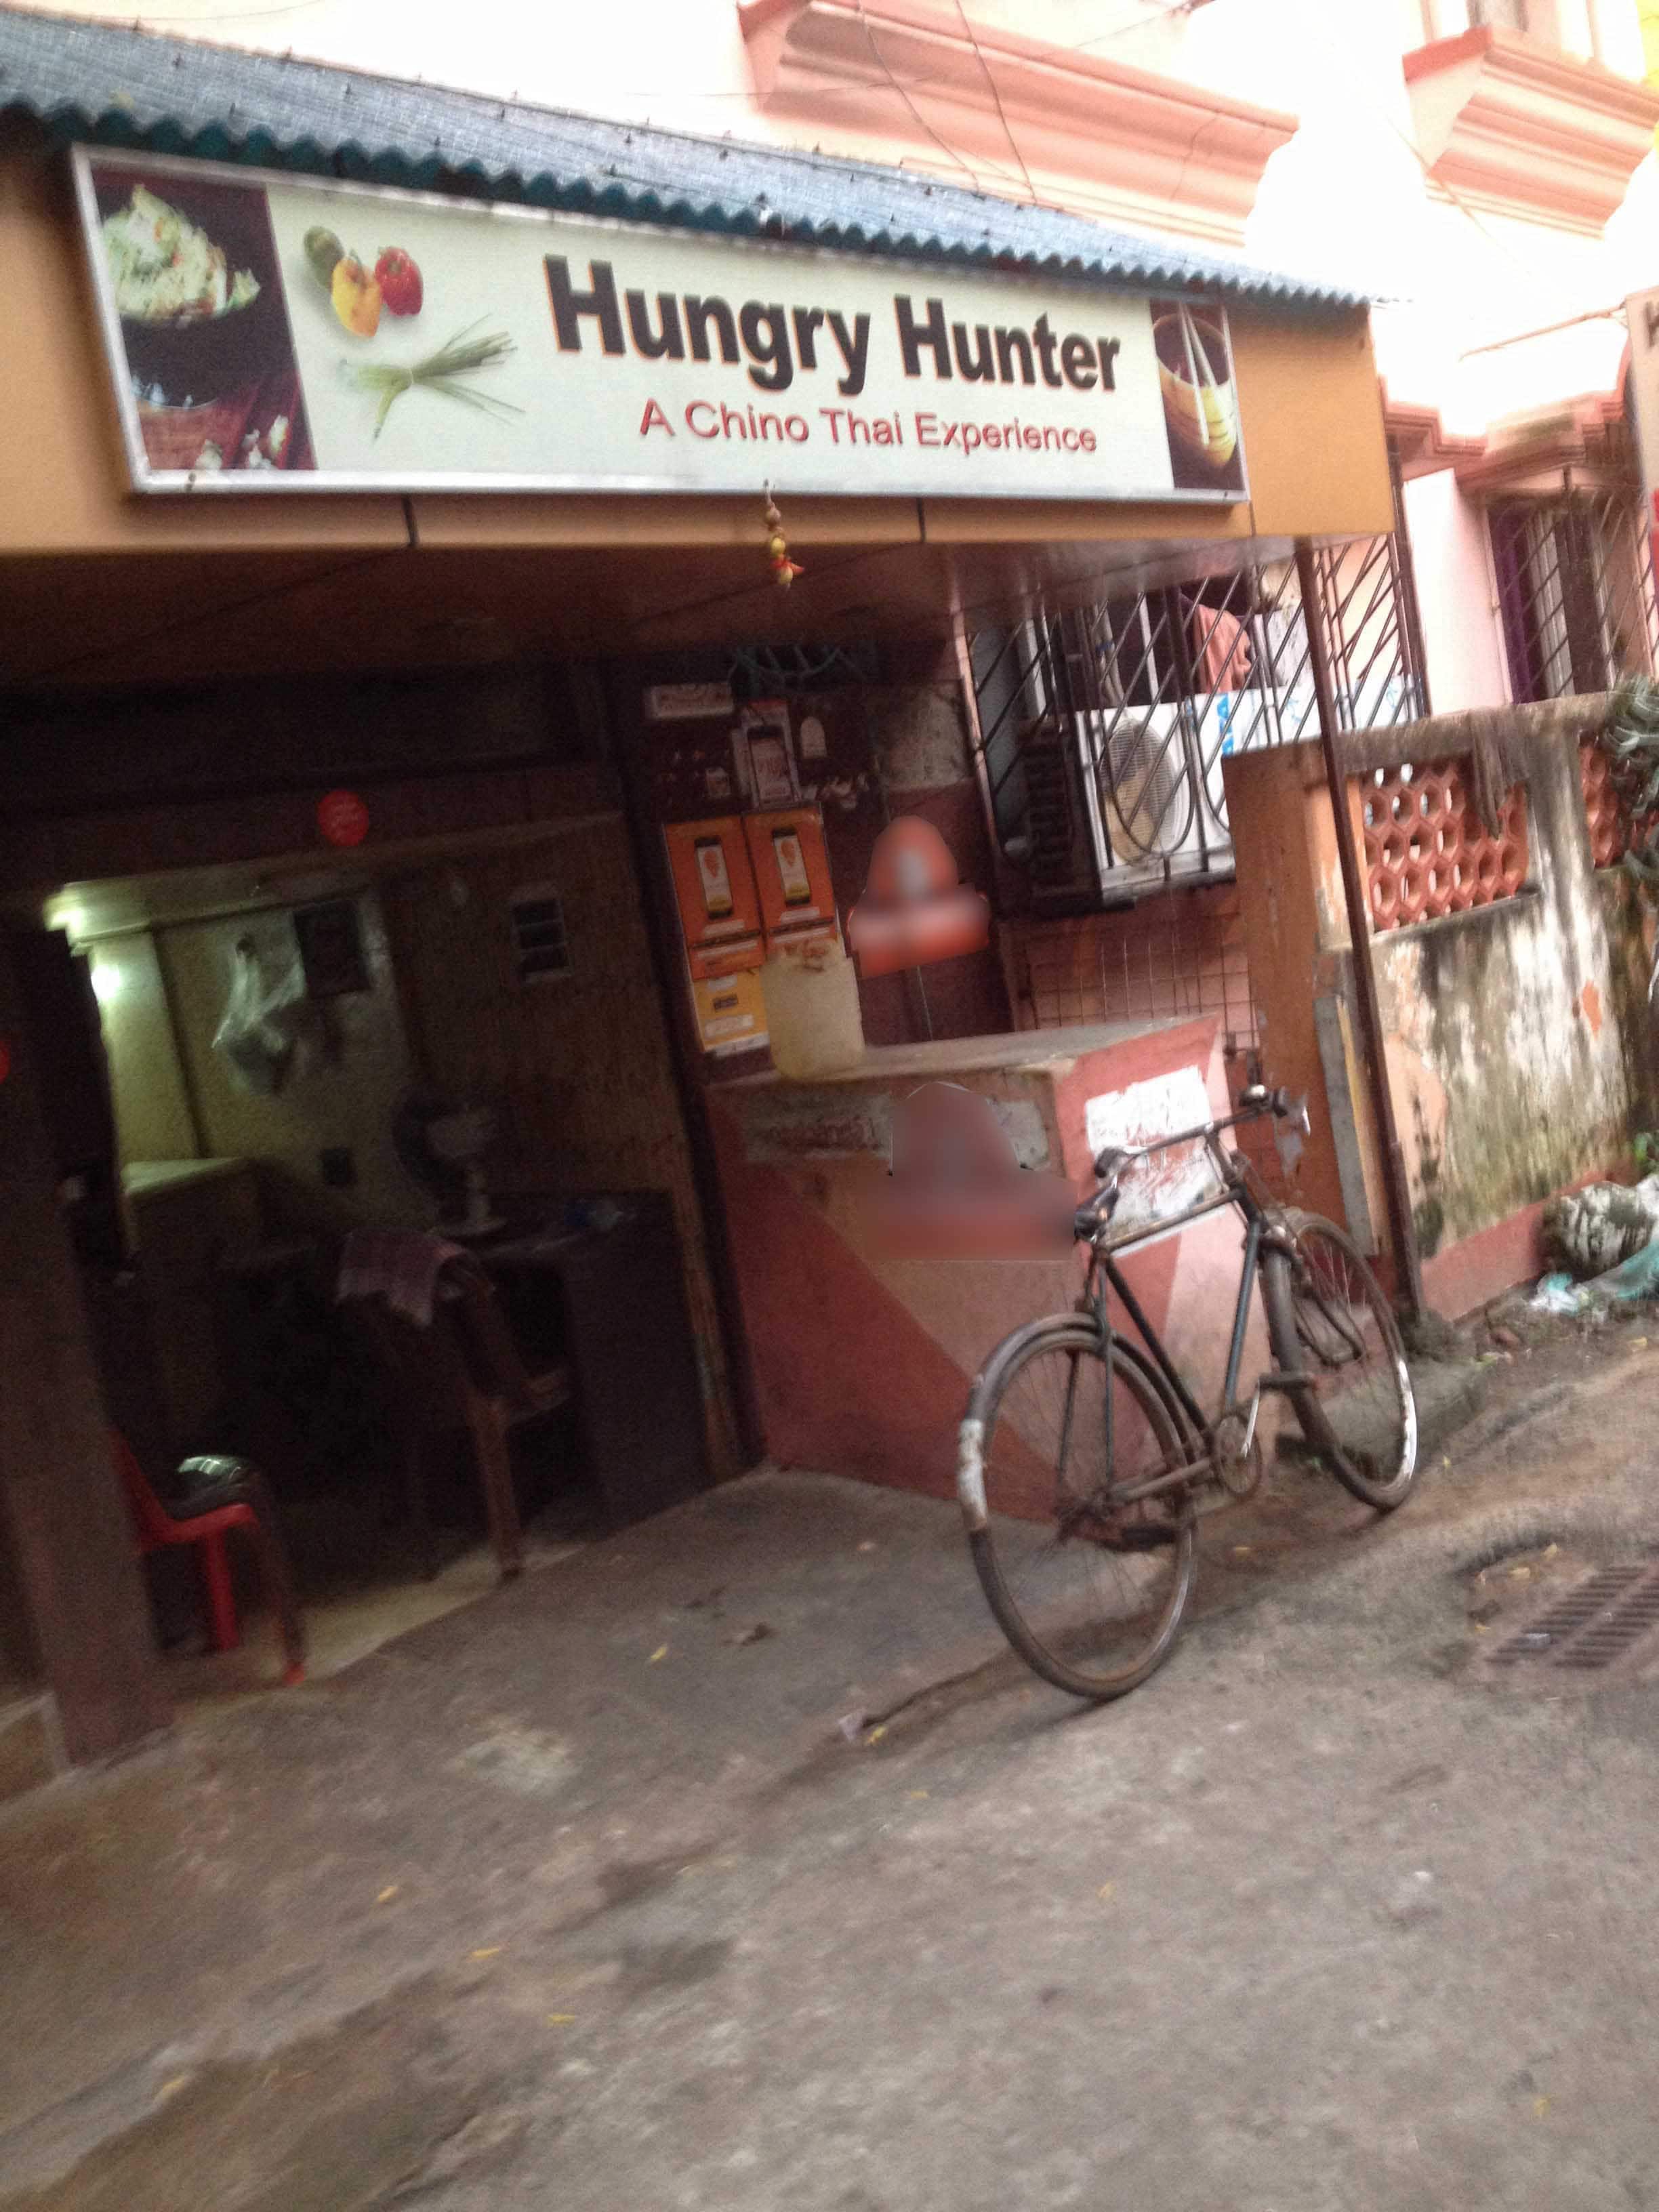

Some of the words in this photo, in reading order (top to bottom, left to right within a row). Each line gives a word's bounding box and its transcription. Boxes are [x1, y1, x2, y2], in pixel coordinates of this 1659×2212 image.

[544, 255, 871, 396] Hungry
[895, 294, 1121, 391] Hunter
[640, 399, 676, 438] A
[685, 401, 810, 443] Chino
[818, 409, 903, 445] Thai
[916, 412, 1098, 454] Experience
